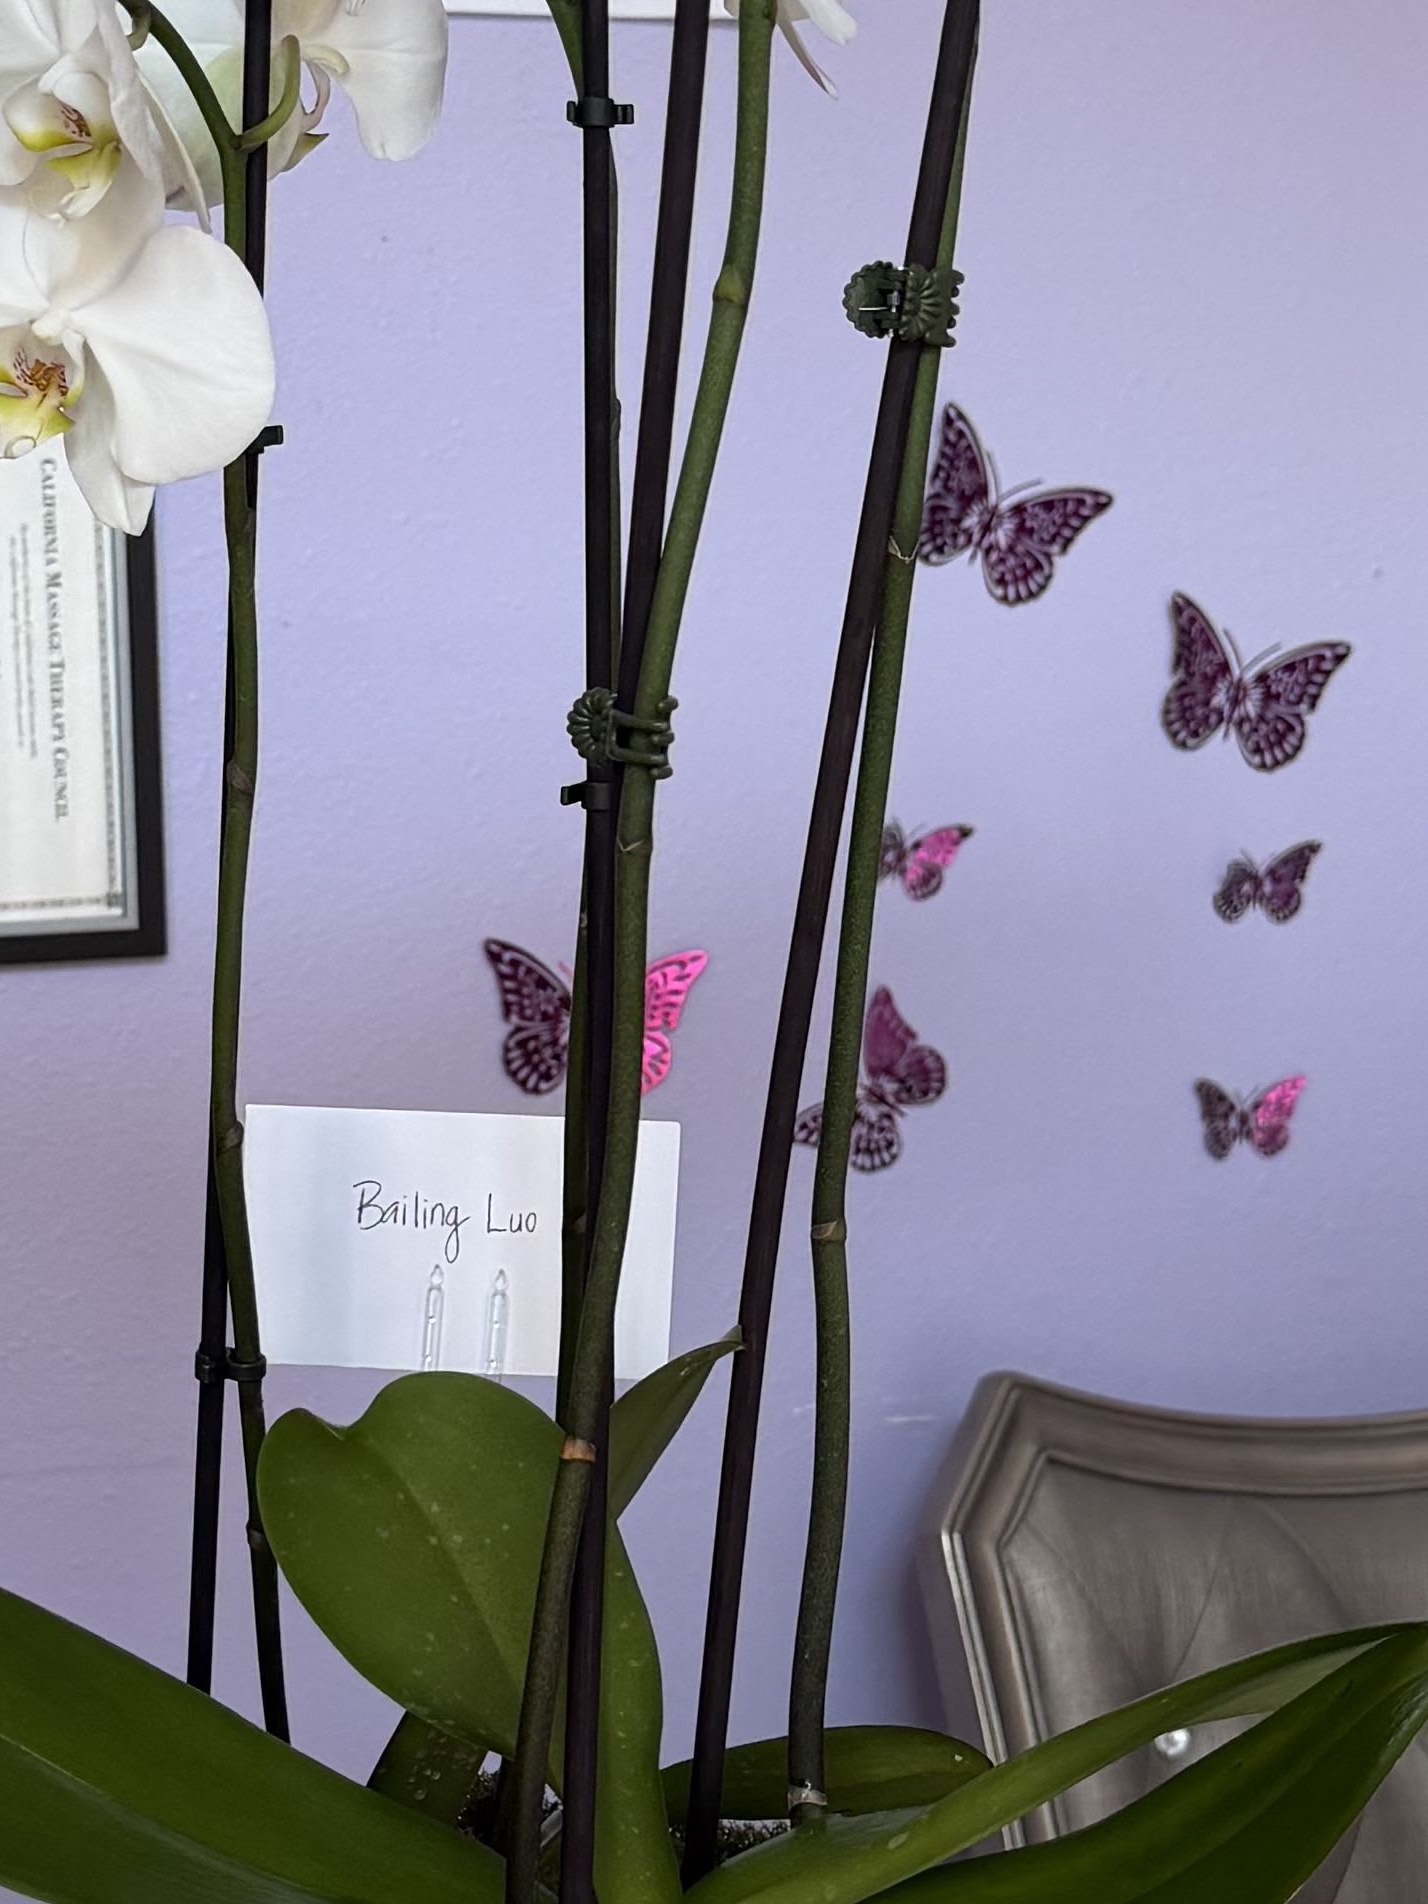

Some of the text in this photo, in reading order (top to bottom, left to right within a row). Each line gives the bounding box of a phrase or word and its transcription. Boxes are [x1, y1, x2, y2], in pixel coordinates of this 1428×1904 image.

[40, 458, 58, 566] CALIFORNIA
[45, 572, 63, 654] MASSAGE
[48, 661, 66, 742] THERAPY
[352, 1179, 538, 1264] Bailing Luo
